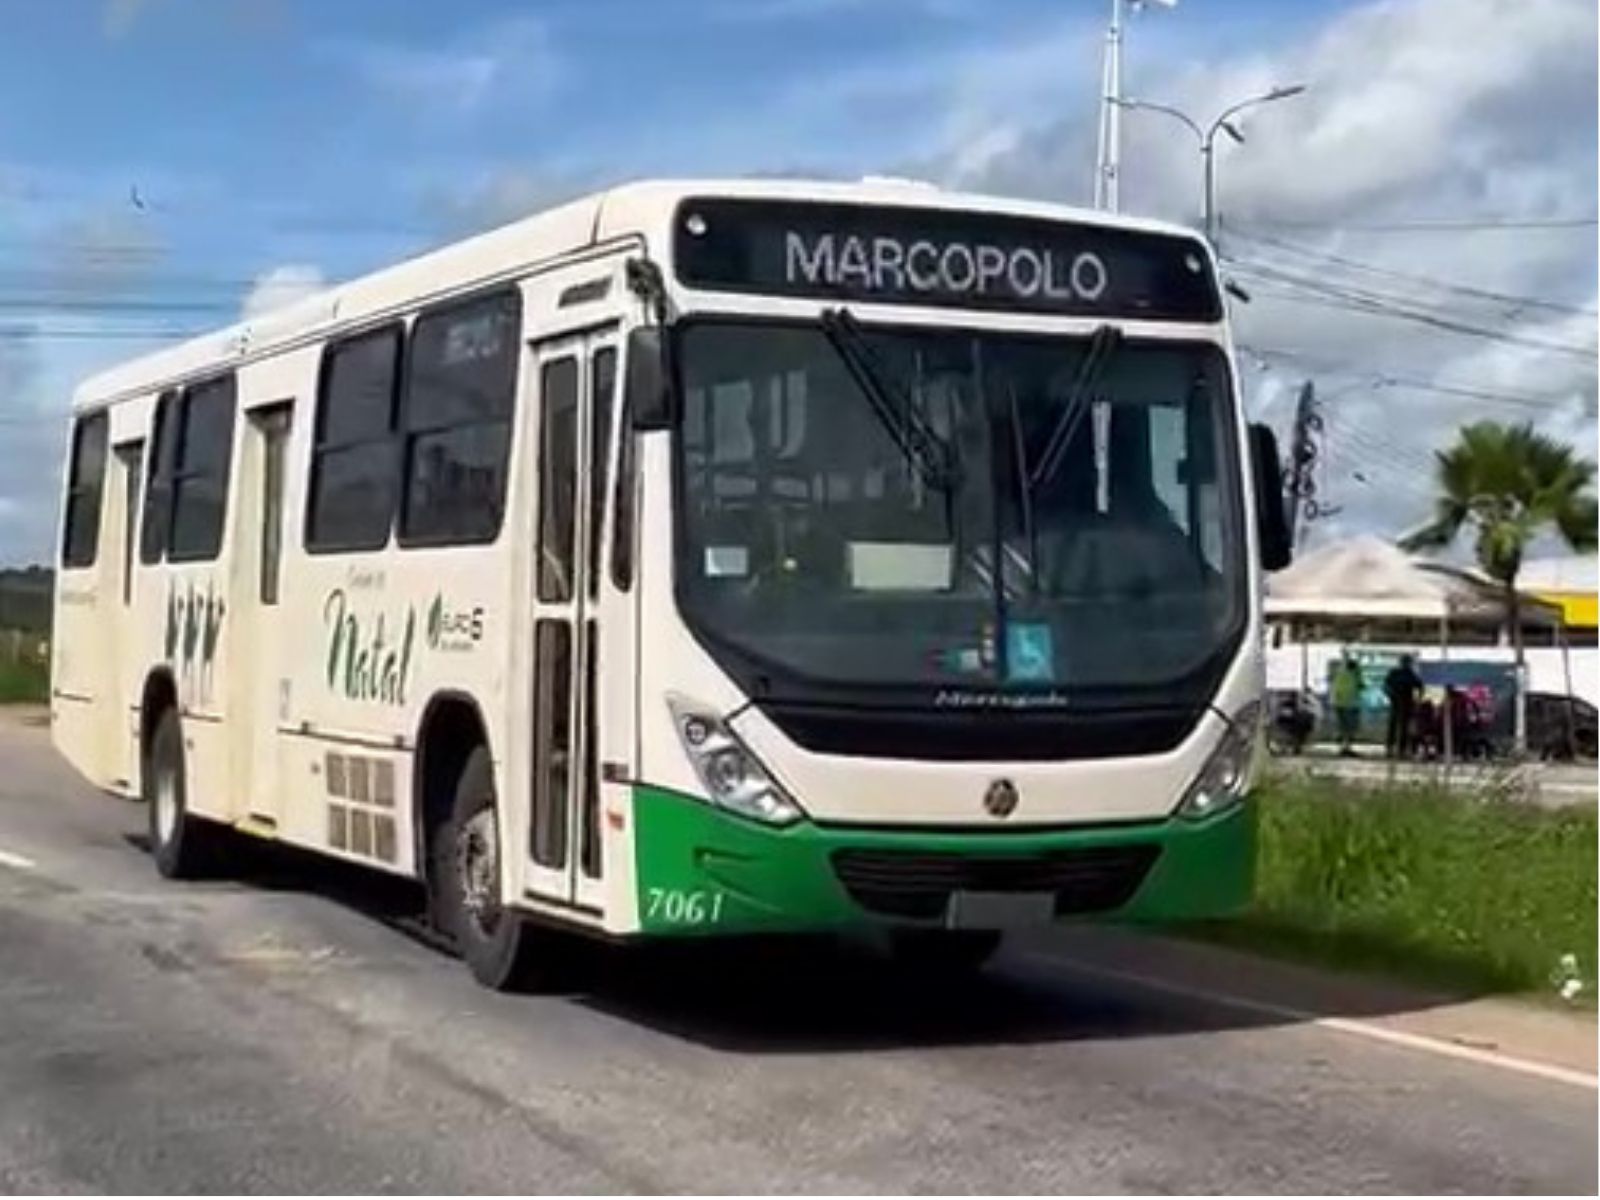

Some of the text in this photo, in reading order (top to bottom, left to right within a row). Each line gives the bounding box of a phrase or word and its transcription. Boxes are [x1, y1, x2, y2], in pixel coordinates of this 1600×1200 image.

[785, 231, 1107, 299] MARCOPOLO
[324, 587, 416, 707] Natal
[646, 887, 723, 925] 7061
